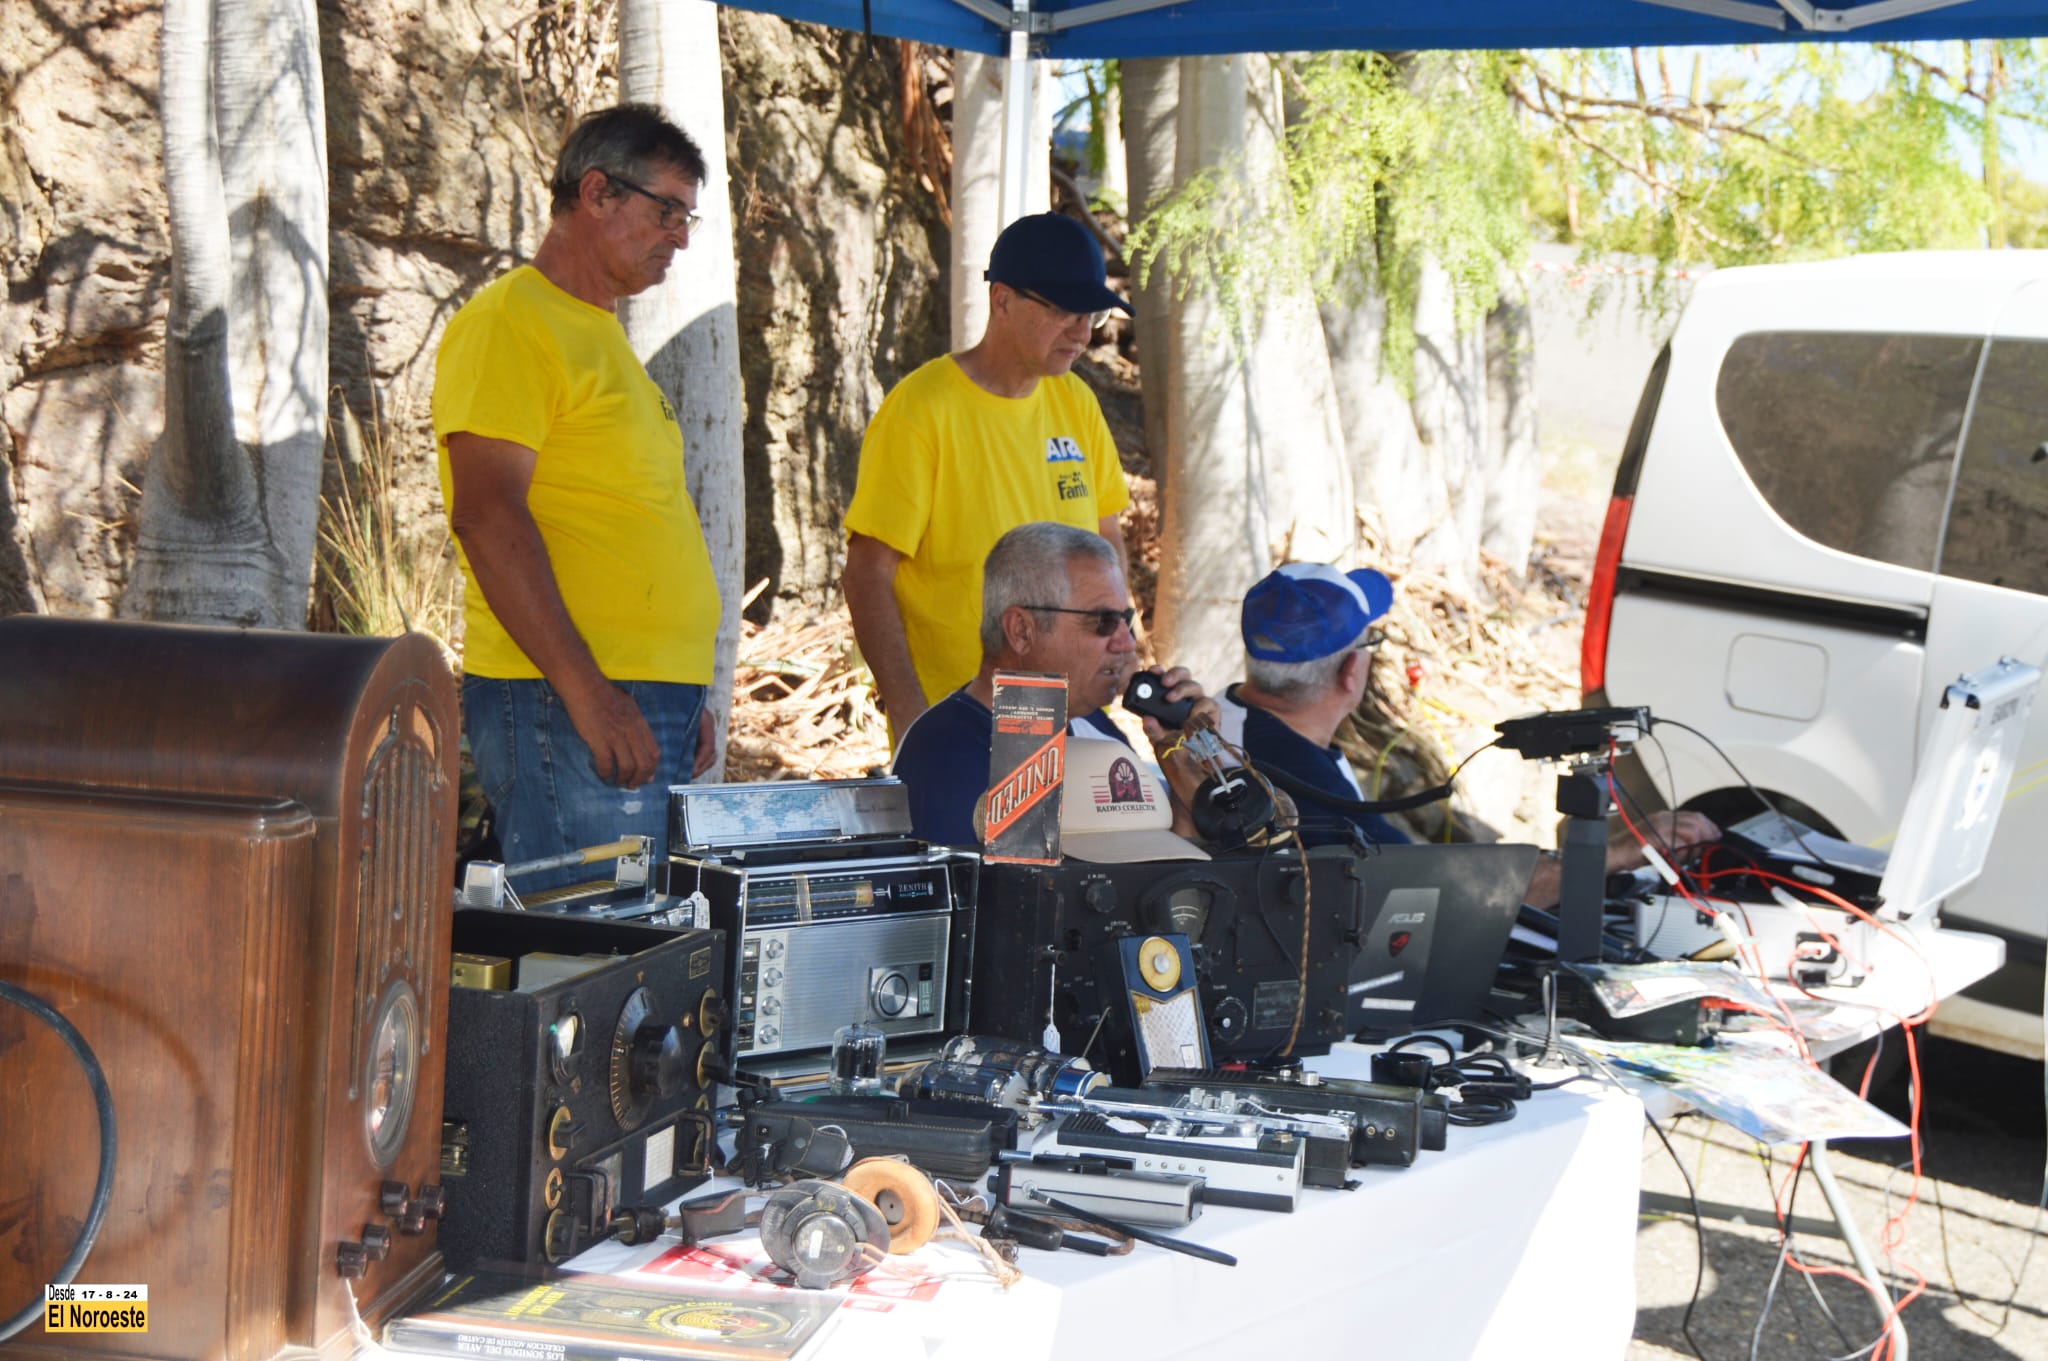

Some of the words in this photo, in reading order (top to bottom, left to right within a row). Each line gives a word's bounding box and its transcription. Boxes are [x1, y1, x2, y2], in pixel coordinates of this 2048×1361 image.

[991, 746, 1060, 825] UNITED
[1096, 804, 1121, 813] RADIO
[898, 882, 928, 893] ZENITH
[1387, 912, 1426, 924] ASUS
